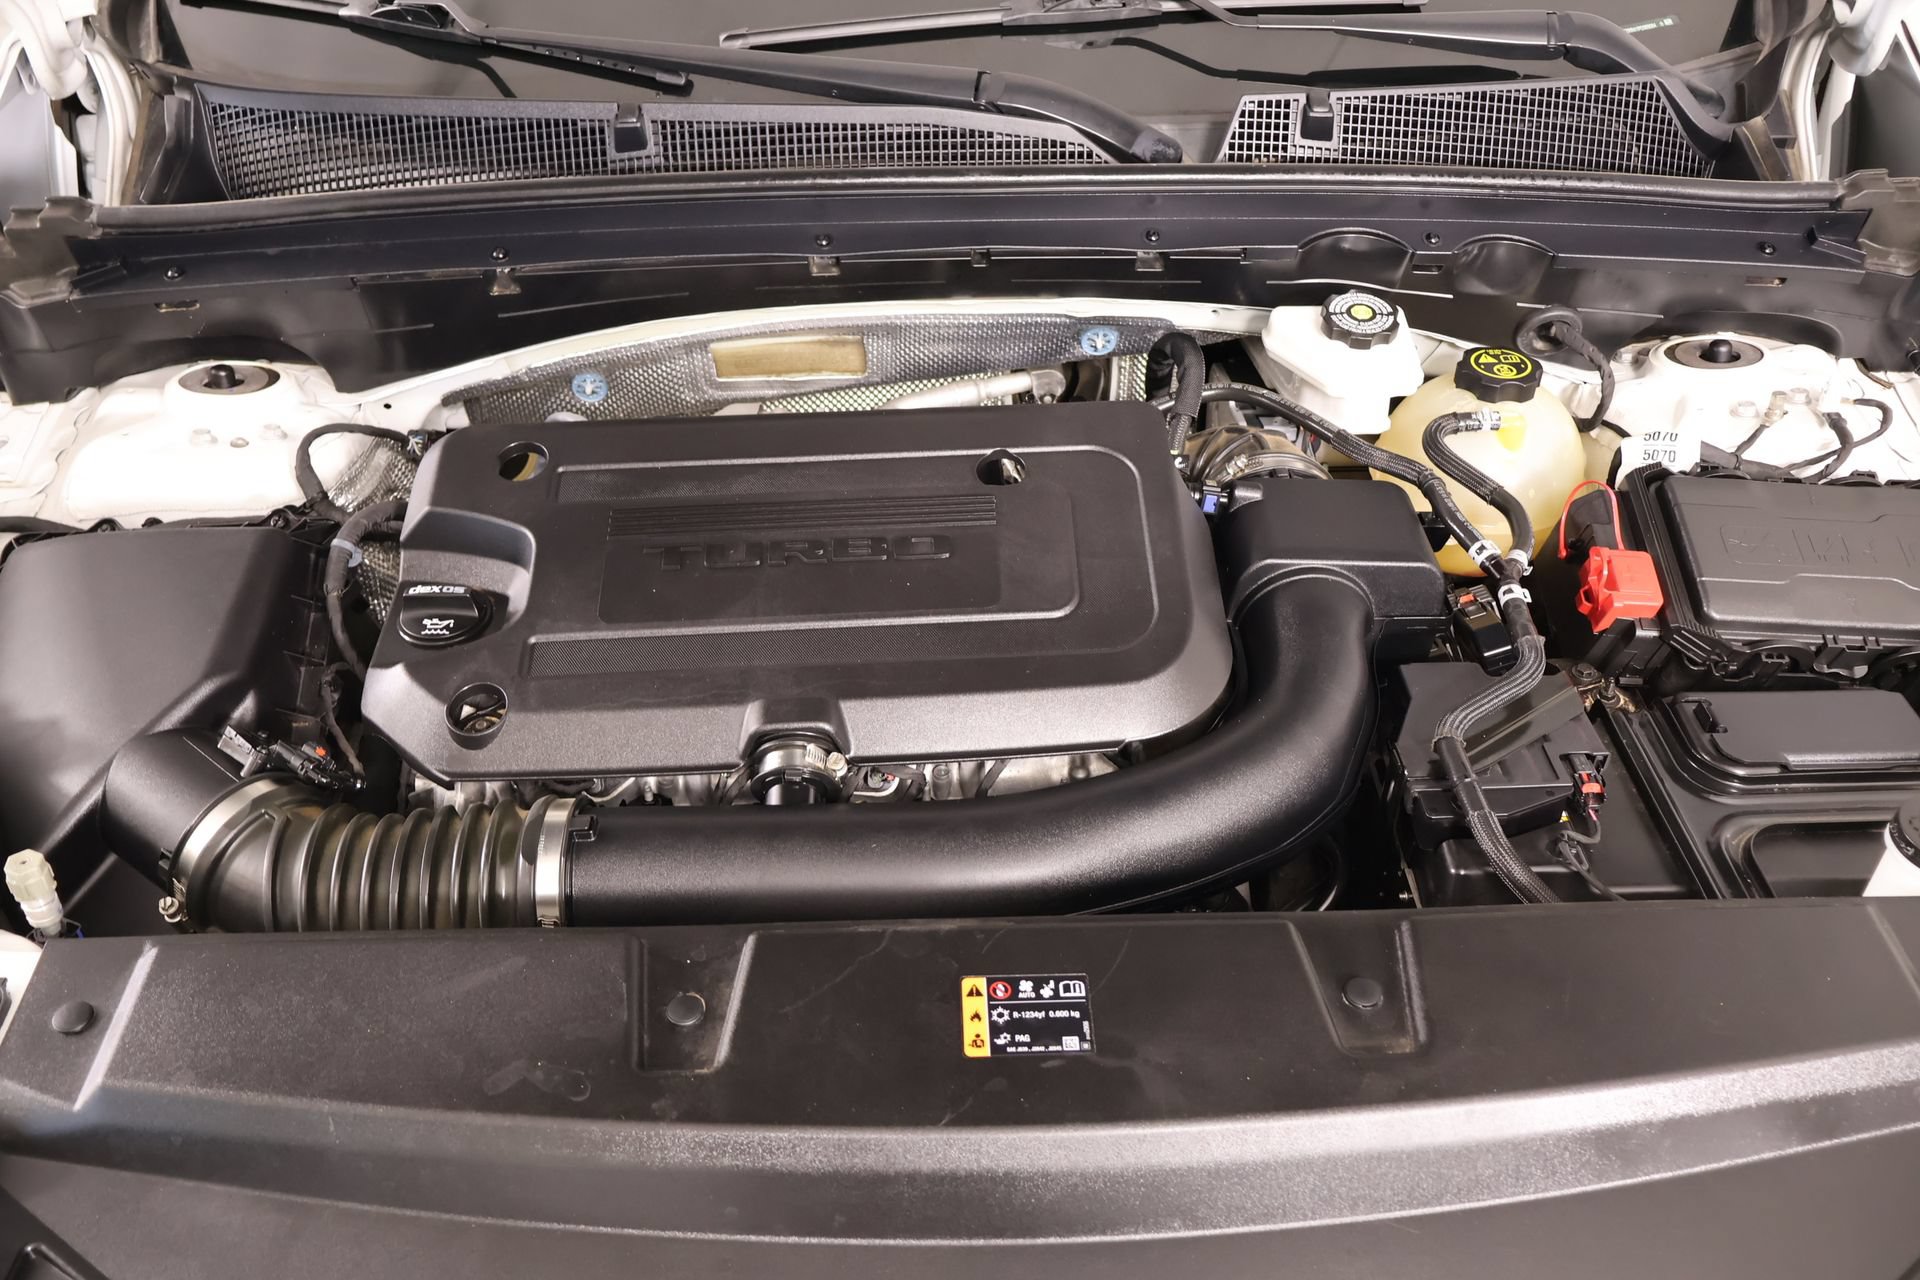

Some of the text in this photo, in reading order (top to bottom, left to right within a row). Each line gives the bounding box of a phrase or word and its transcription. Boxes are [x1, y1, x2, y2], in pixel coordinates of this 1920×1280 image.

[1643, 431, 1679, 442] 5070
[1642, 449, 1677, 463] 5070
[642, 535, 952, 572] TURBO
[1018, 991, 1036, 999] AUTO
[1012, 1010, 1046, 1020] R-1234yf
[1070, 1009, 1081, 1019] kg
[1014, 1033, 1031, 1043] PAG
